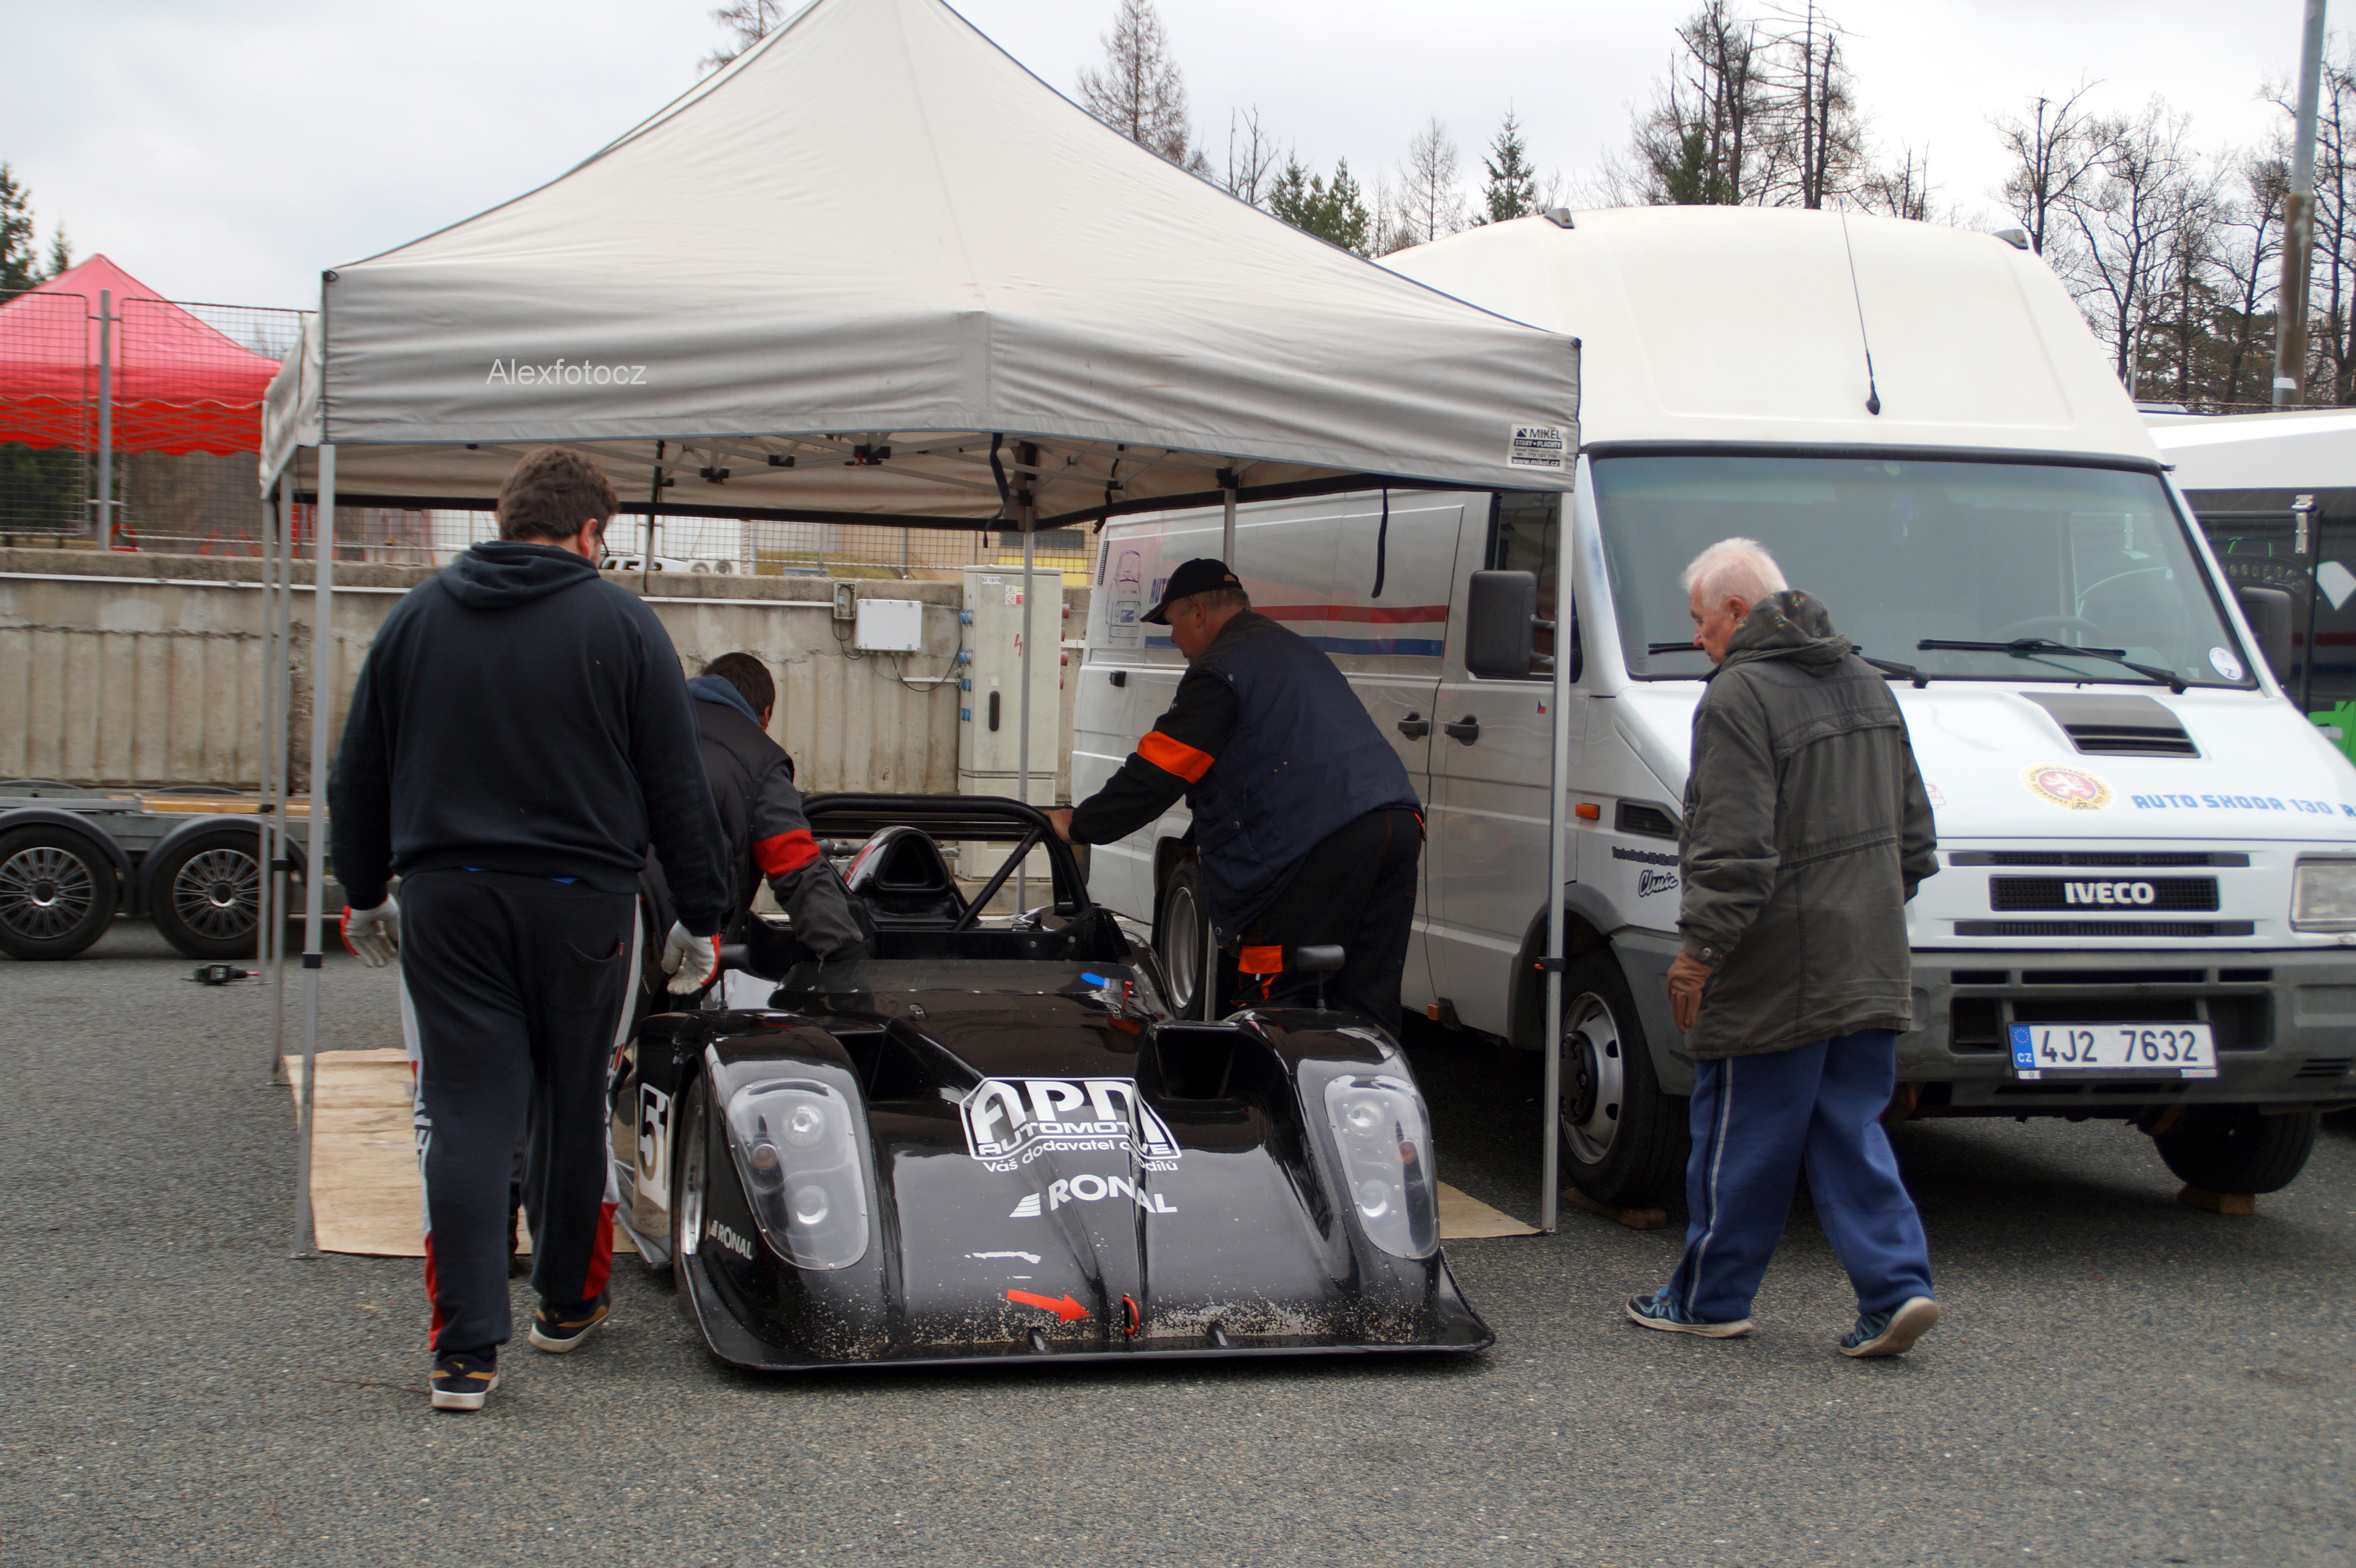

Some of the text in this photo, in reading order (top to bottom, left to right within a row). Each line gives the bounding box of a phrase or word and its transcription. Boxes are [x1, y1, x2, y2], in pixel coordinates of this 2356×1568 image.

[1530, 428, 1561, 439] MIKEL
[1513, 458, 1559, 466] www.mikel.cz
[2131, 794, 2356, 818] AUTO SKODA 130 R
[2065, 882, 2155, 904] IVECO
[2017, 1052, 2032, 1063] CZ
[2040, 1030, 2198, 1062] 4J2 7632
[978, 1121, 1171, 1155] AUTOMOTIVE
[983, 1157, 1018, 1172] Váš
[1022, 1140, 1115, 1164] dodavatel
[1048, 1174, 1178, 1214] RONAL
[718, 1223, 754, 1261] RONAL
